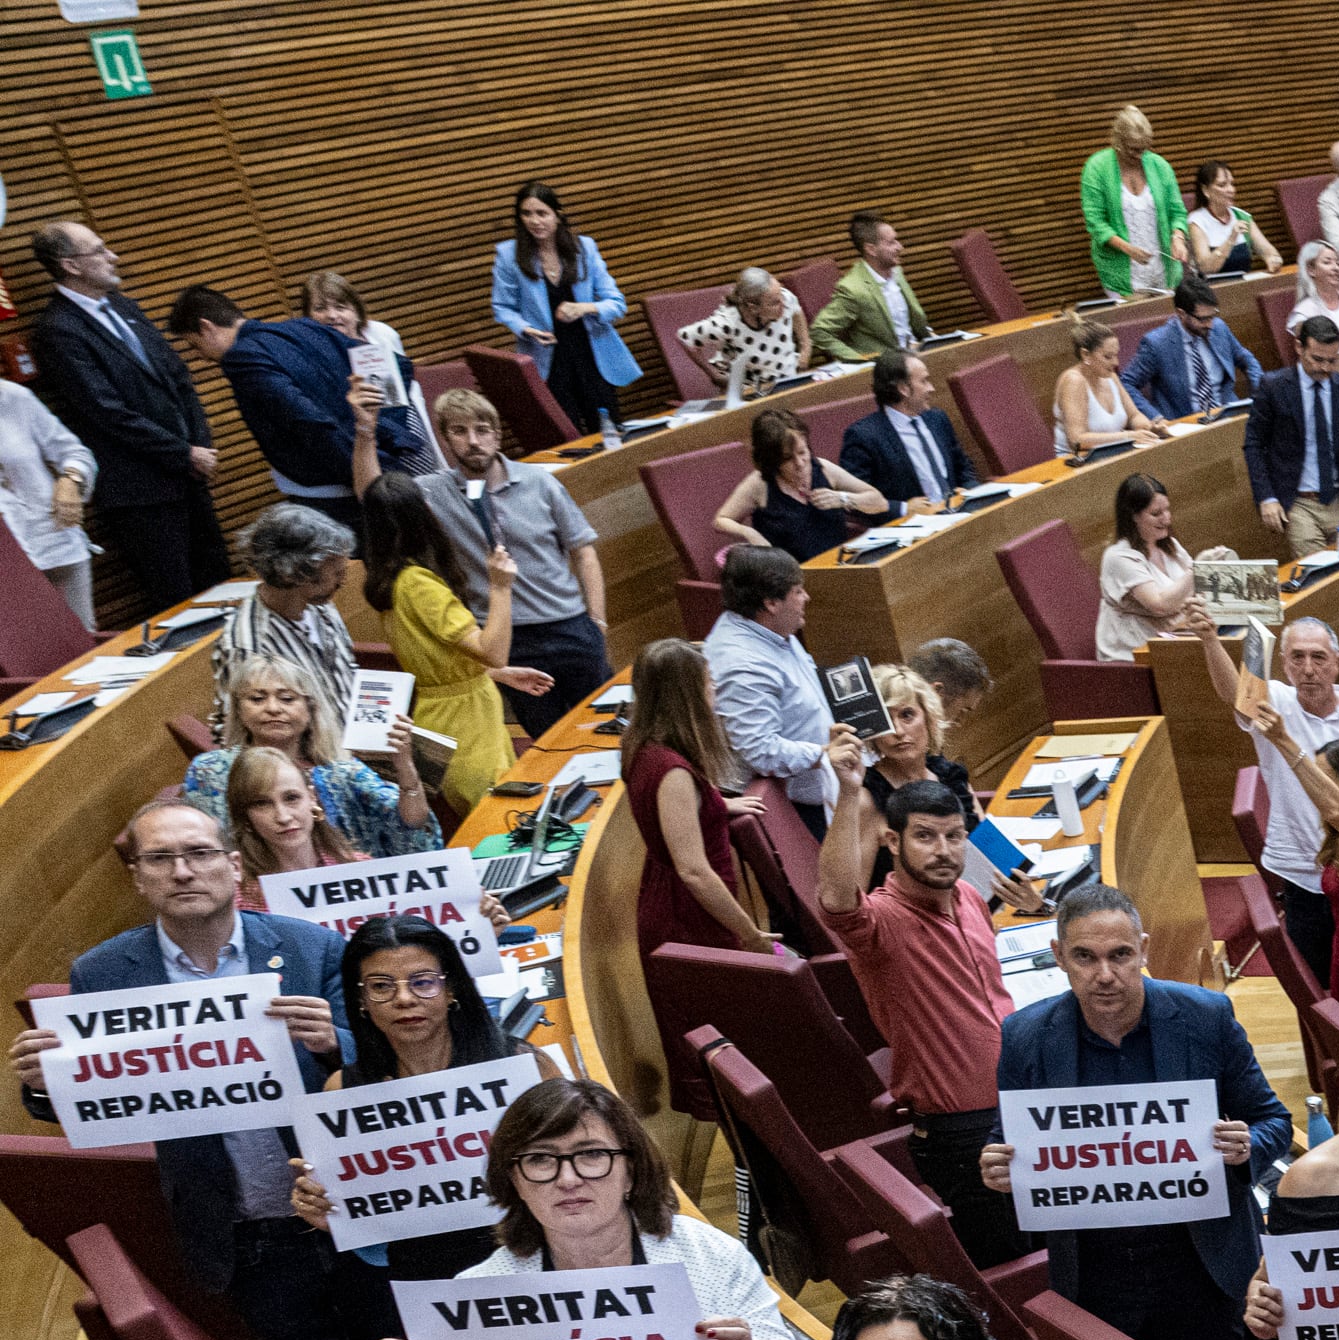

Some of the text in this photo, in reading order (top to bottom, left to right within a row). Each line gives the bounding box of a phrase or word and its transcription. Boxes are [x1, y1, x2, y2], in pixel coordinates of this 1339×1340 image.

[291, 865, 450, 909] VERITAT
[66, 992, 249, 1039] VERITAT
[73, 1033, 265, 1084] JUSTÍCIA
[75, 1071, 283, 1122] REPARACIÓ
[317, 1078, 509, 1139] VERITAT
[1028, 1097, 1190, 1131] VERITAT
[1033, 1128, 1198, 1172] JUSTÍCIA
[344, 1178, 492, 1220] REPARA
[1031, 1170, 1210, 1208] REPARACIÓ
[432, 1284, 655, 1330] VERITAT
